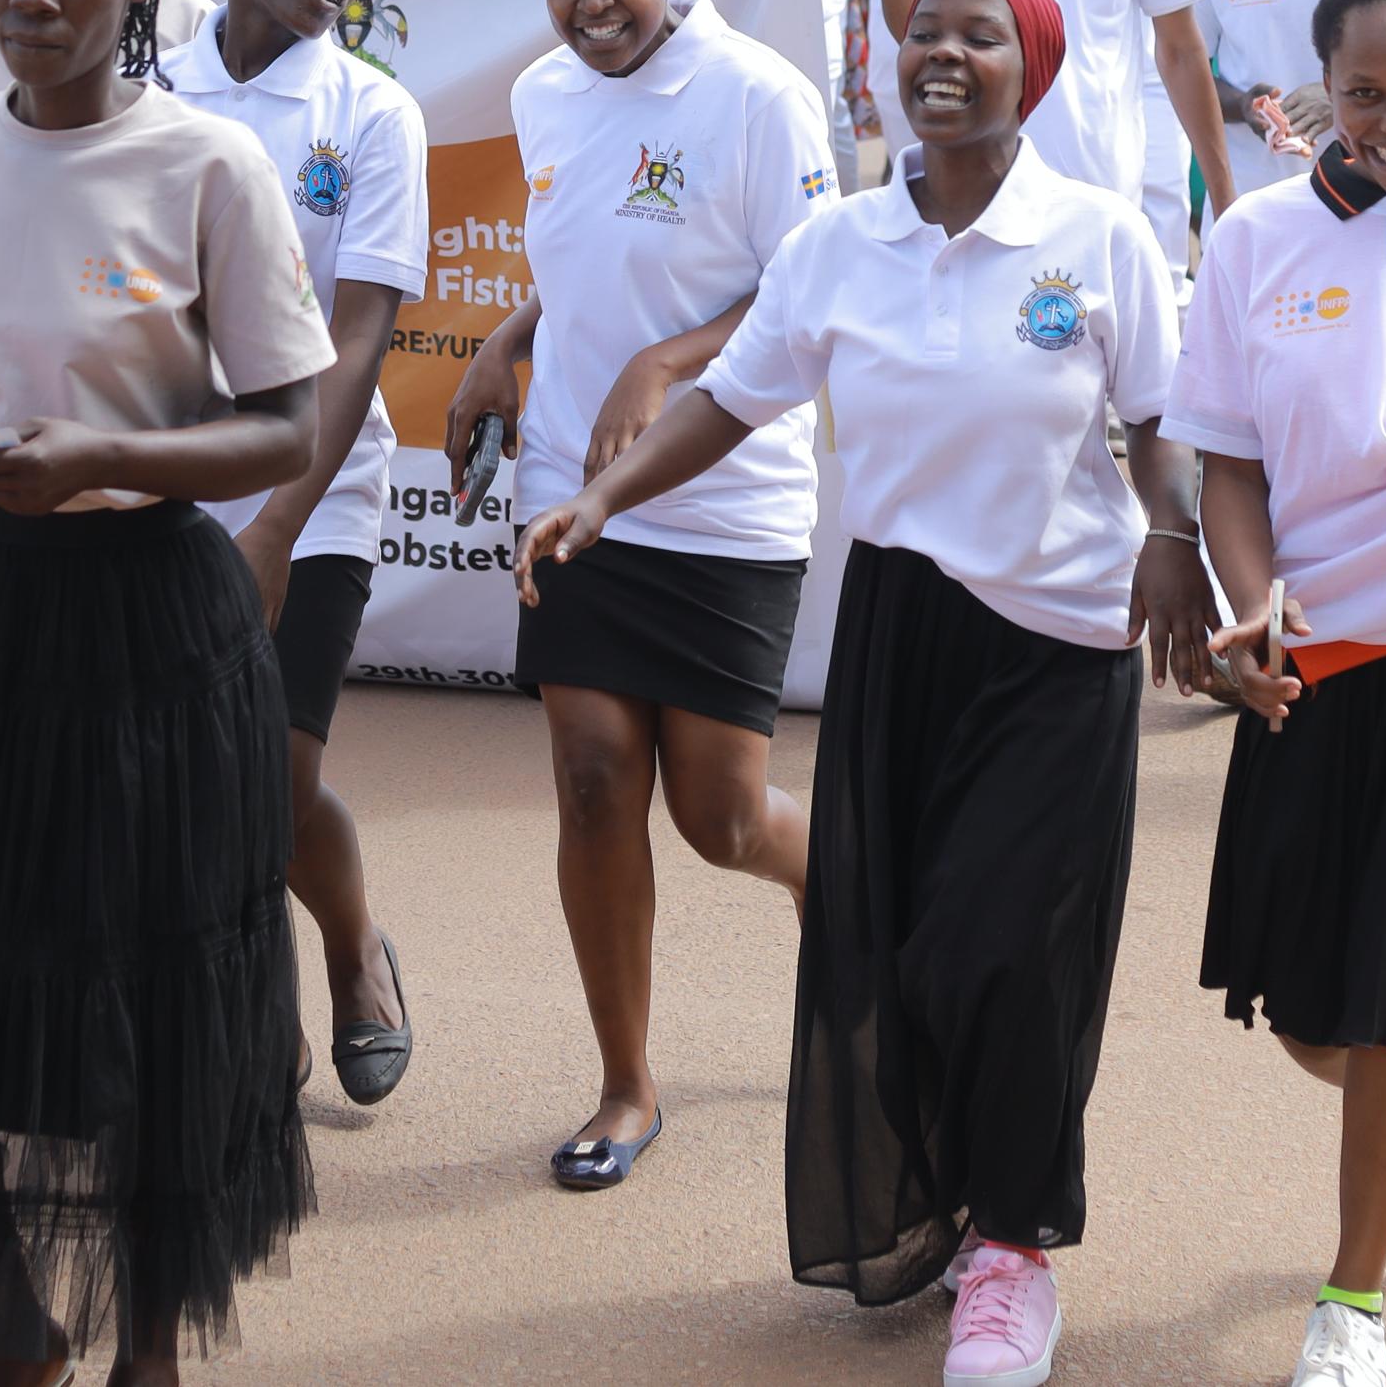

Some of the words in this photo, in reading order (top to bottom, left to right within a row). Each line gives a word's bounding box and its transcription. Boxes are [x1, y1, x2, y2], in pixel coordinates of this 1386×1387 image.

[428, 216, 524, 258] ght:
[615, 208, 646, 220] MINISTRY
[646, 213, 656, 222] OF
[657, 215, 687, 226] HEALTH
[436, 265, 536, 309] Fistu
